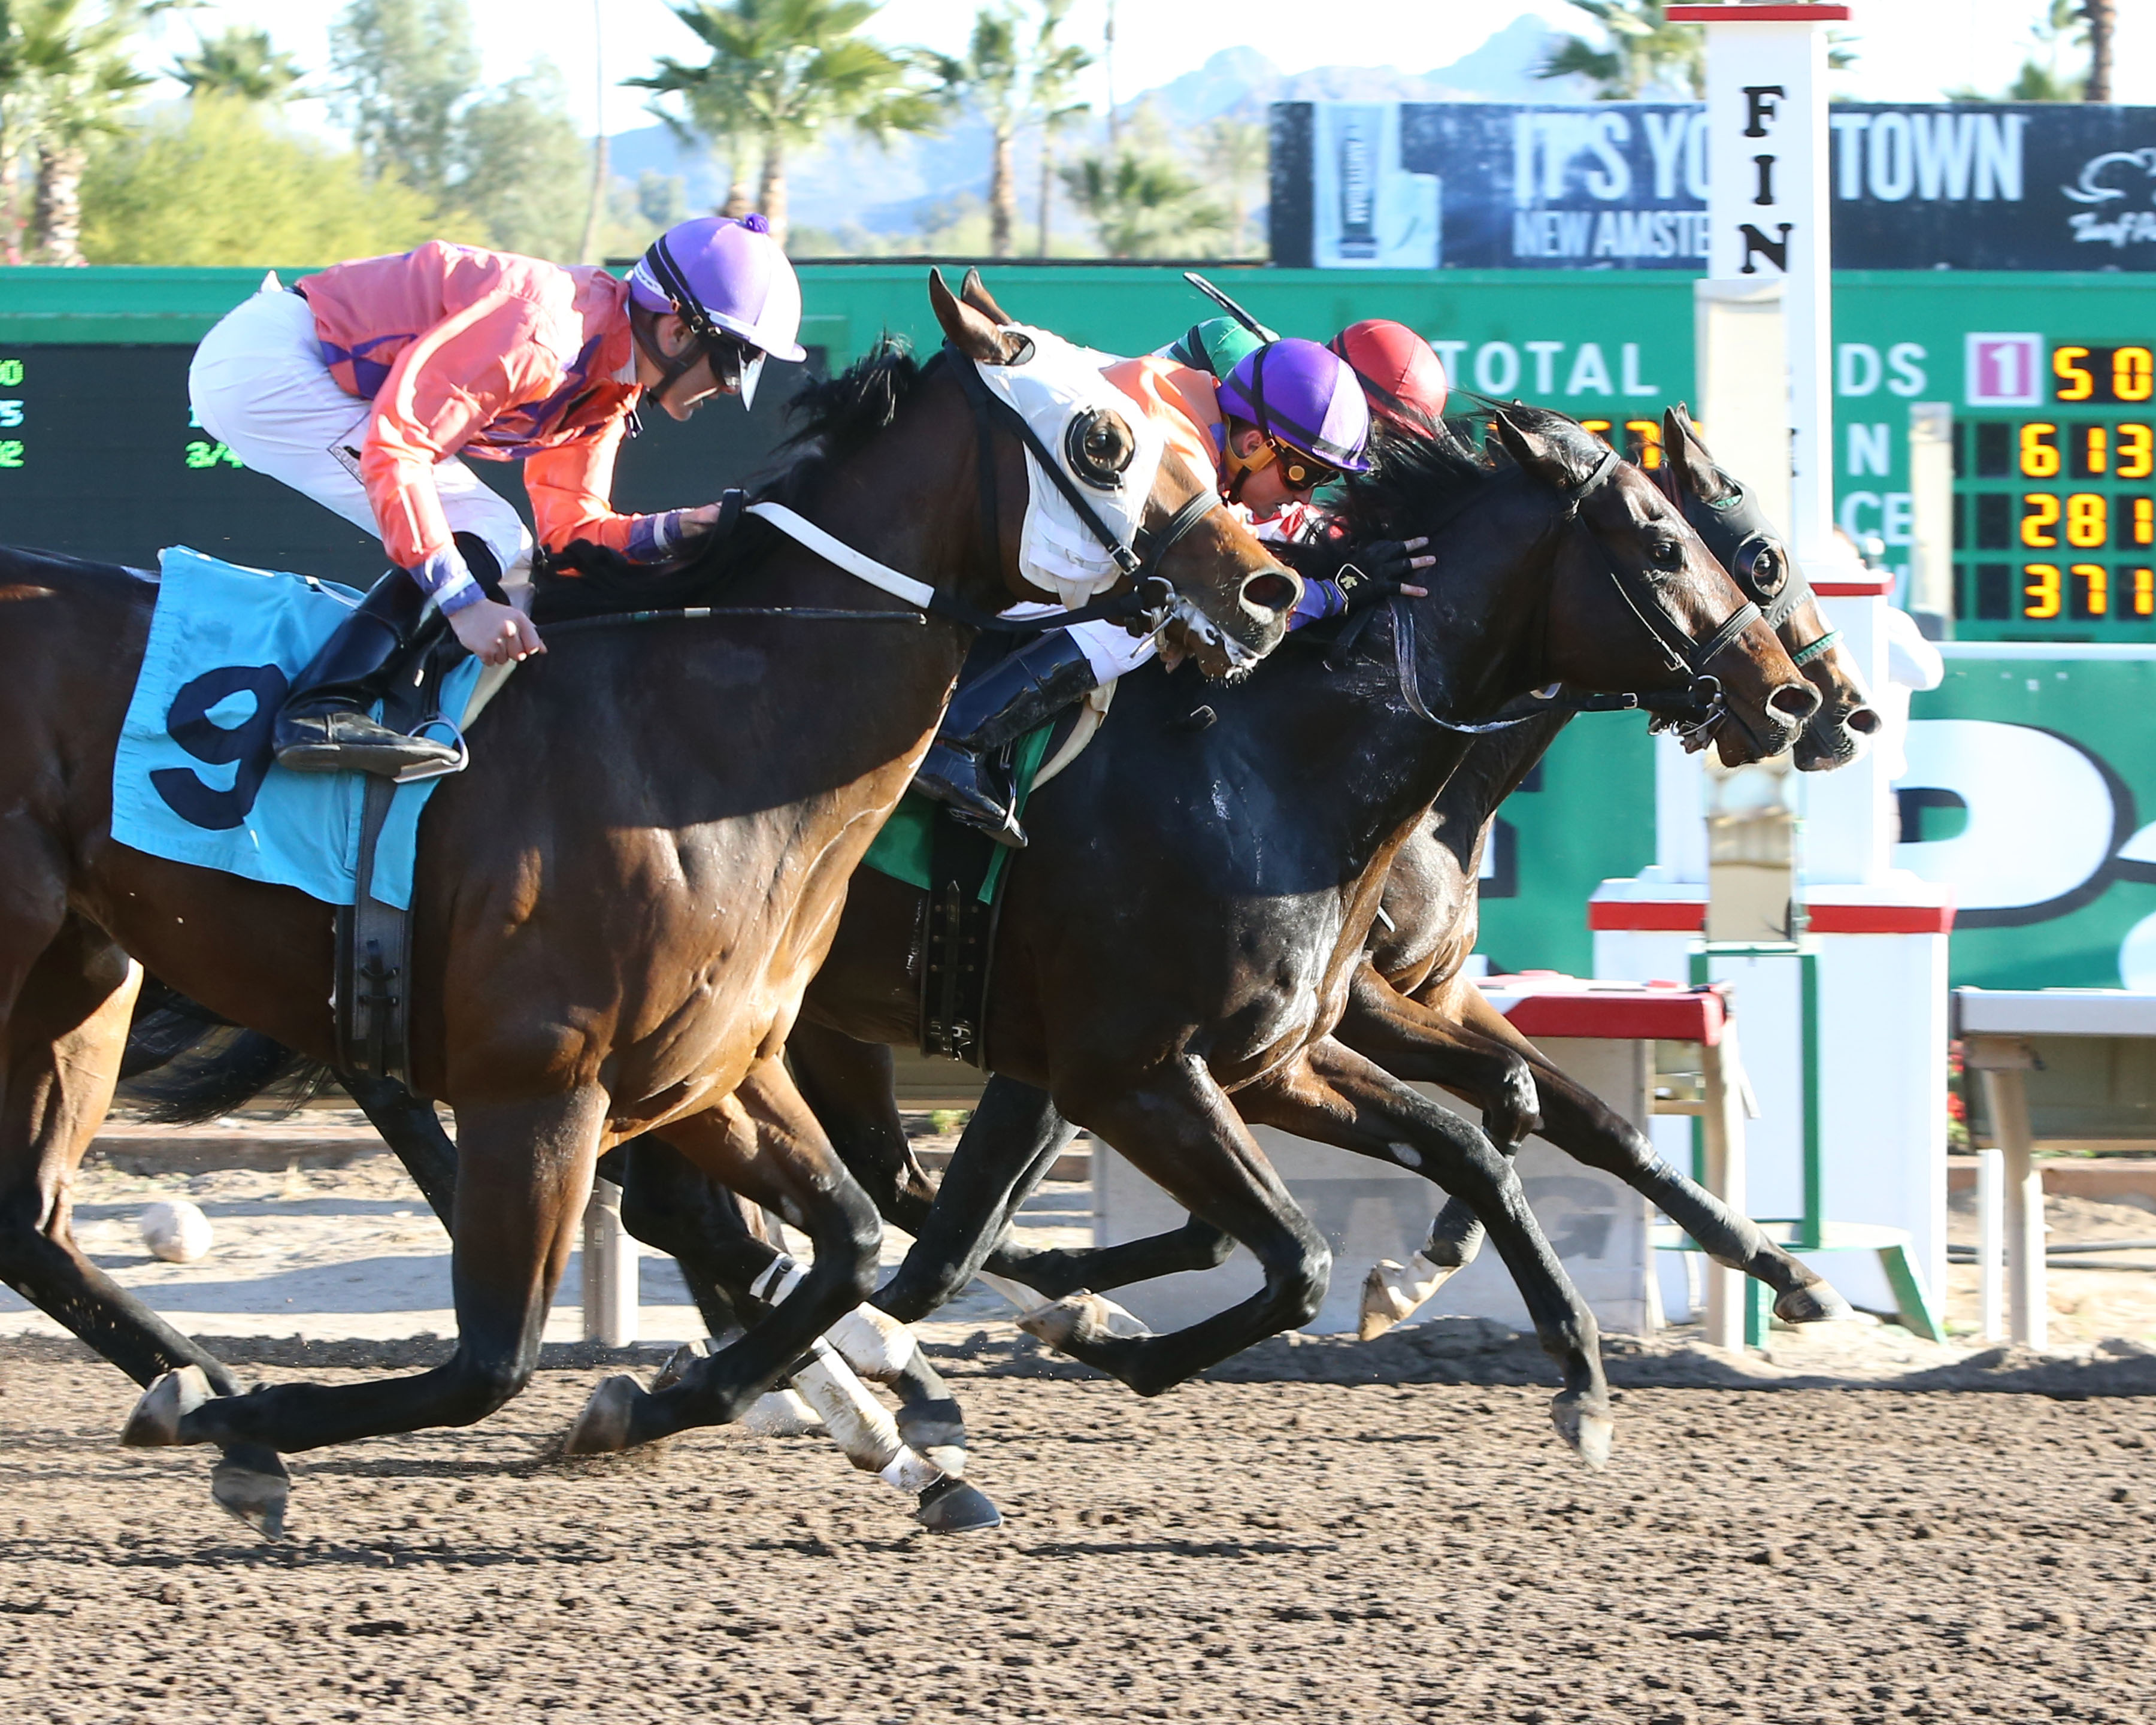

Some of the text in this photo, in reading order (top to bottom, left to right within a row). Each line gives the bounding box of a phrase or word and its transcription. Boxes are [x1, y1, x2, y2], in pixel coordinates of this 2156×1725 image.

[1830, 111, 2027, 201] TOWN
[1512, 210, 1592, 258] NEW
[1430, 340, 1661, 397] TOTAL
[1990, 344, 2018, 396] 1
[2020, 423, 2154, 477] 613
[2020, 493, 2154, 547] 281
[2024, 564, 2154, 618] 371
[149, 663, 289, 830] 9
